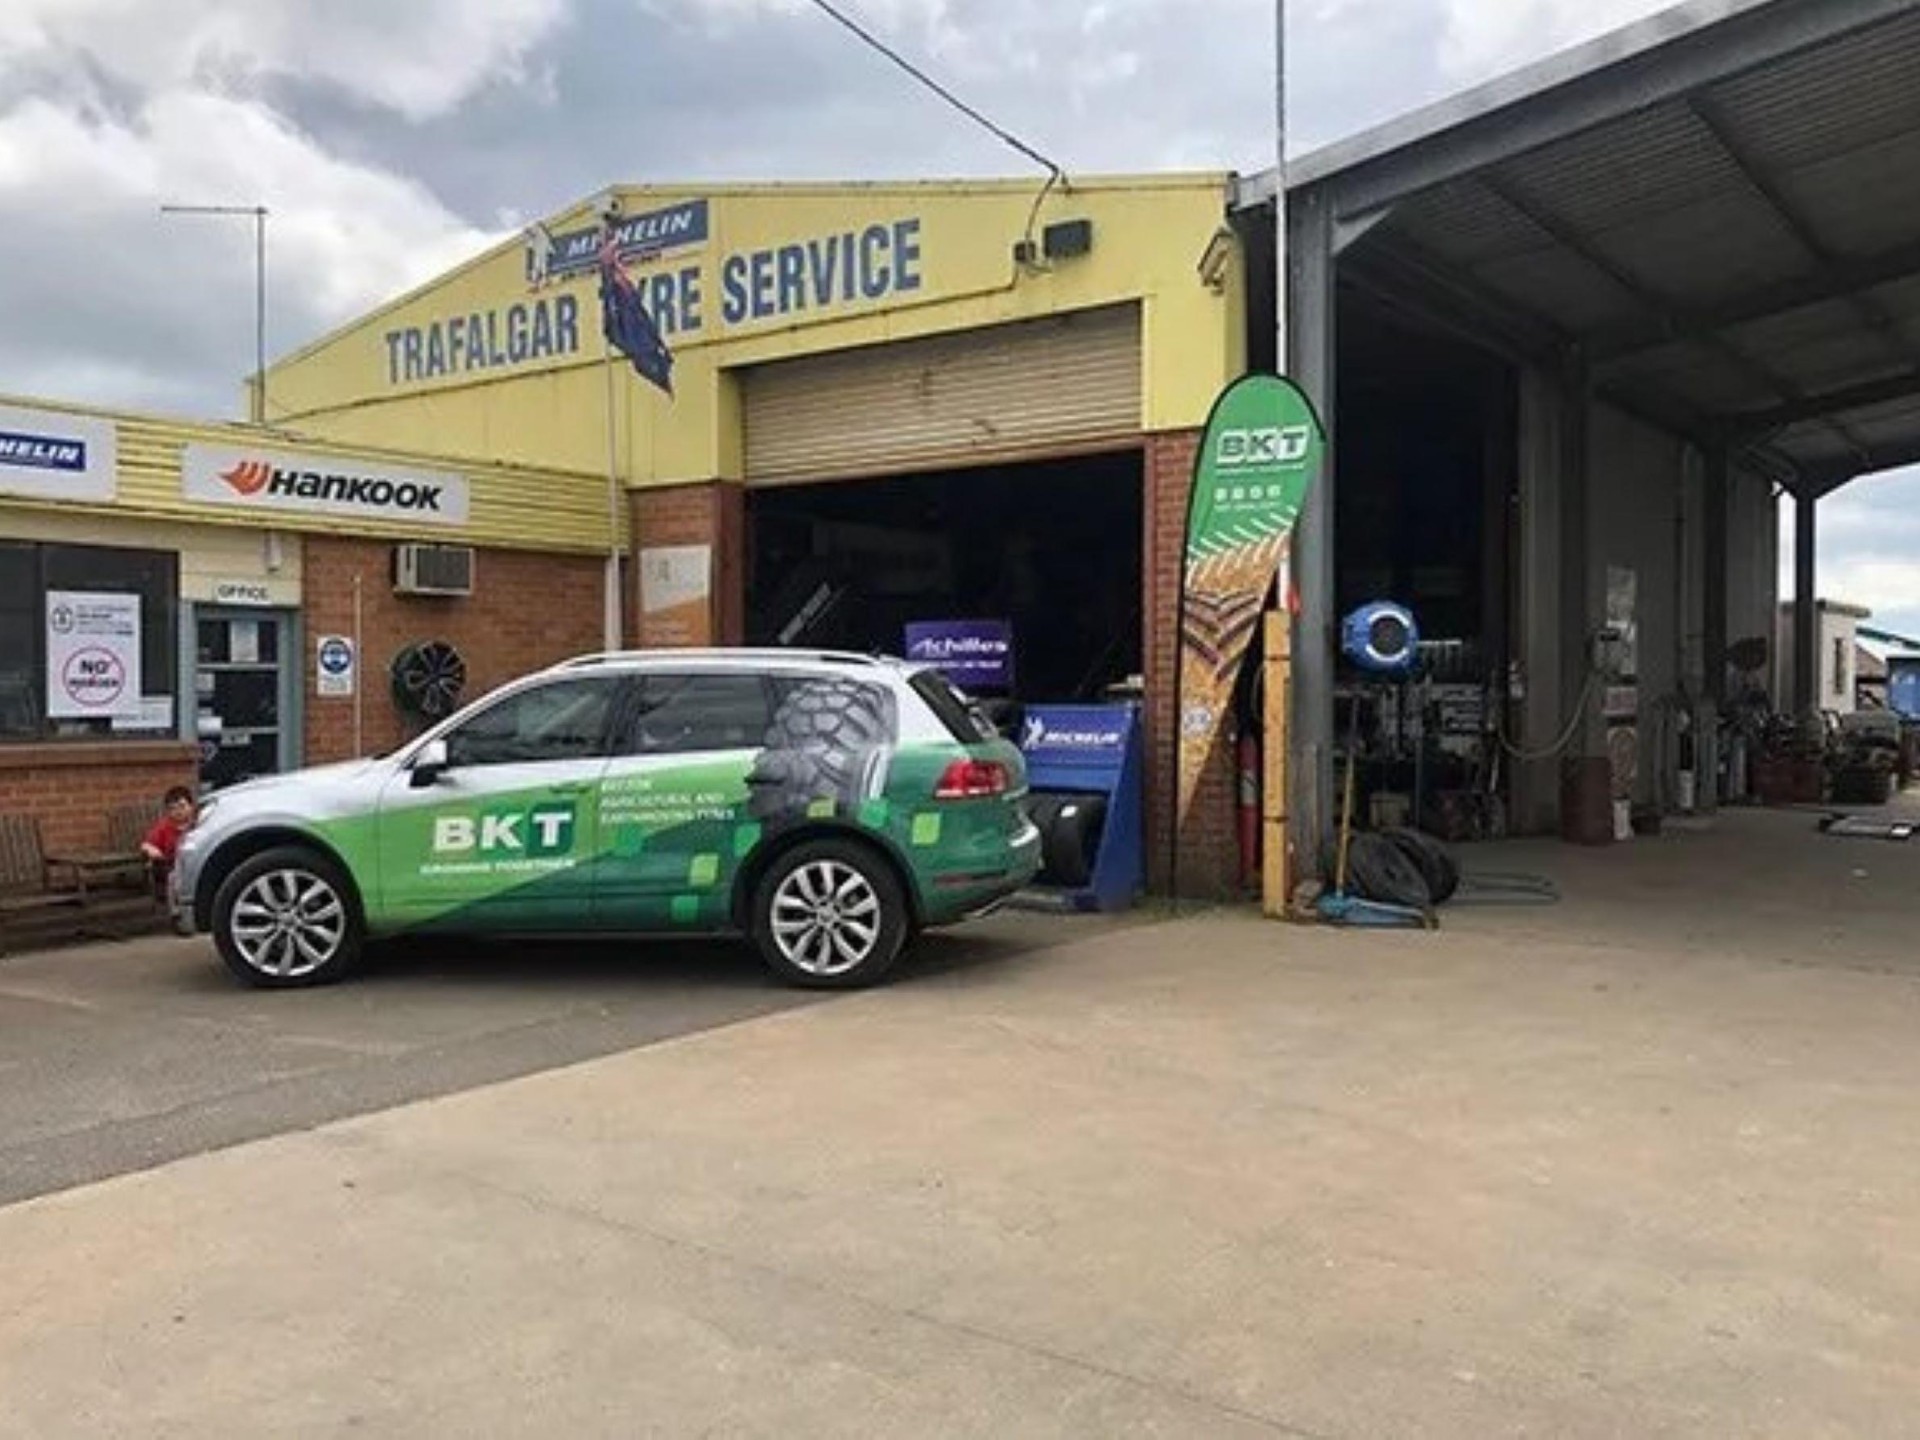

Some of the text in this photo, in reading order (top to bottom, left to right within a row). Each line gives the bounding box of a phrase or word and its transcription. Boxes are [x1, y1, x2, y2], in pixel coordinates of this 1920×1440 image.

[568, 209, 692, 257] MIHELIN
[385, 218, 922, 385] TRAFALGAR RE SERVICE
[1219, 428, 1306, 460] BKT
[217, 584, 268, 599] OFFICE
[910, 637, 1008, 652] Achilles
[80, 660, 109, 674] NO
[1045, 731, 1120, 744] MICHELIN
[434, 812, 573, 851] BKT
